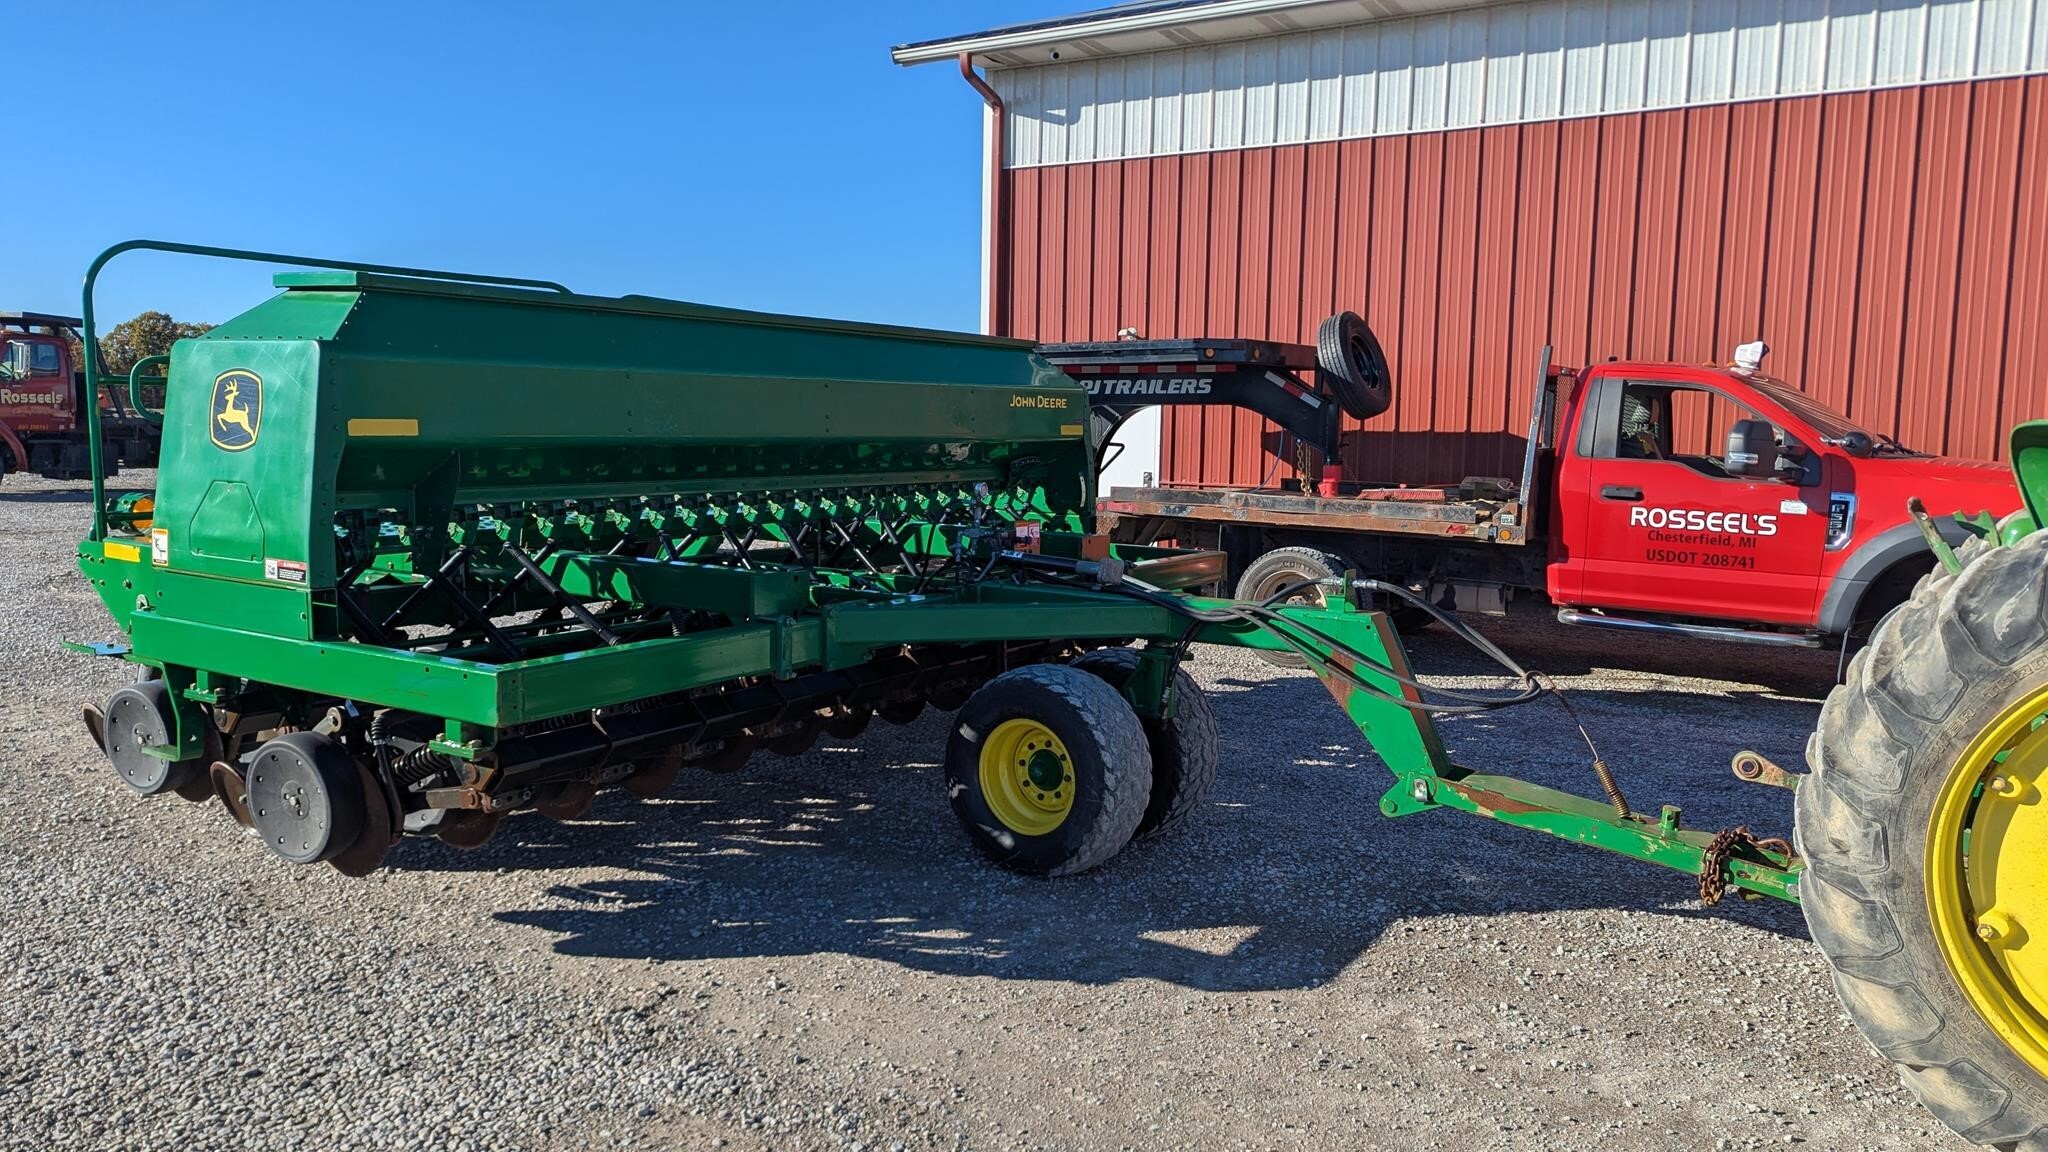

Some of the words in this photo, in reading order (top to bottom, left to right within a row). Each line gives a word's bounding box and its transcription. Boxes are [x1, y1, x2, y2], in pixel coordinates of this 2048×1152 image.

[1104, 378, 1213, 395] TRAILERS
[0, 388, 64, 404] Rosseels
[1010, 394, 1036, 408] JOHN
[1037, 395, 1068, 409] DEERE
[1630, 505, 1778, 536] ROSSEEL'S
[1647, 530, 1735, 548] Chesterfield,
[1739, 537, 1757, 548] MI
[1646, 549, 1698, 564] USDOT
[1702, 553, 1756, 569] 208741
